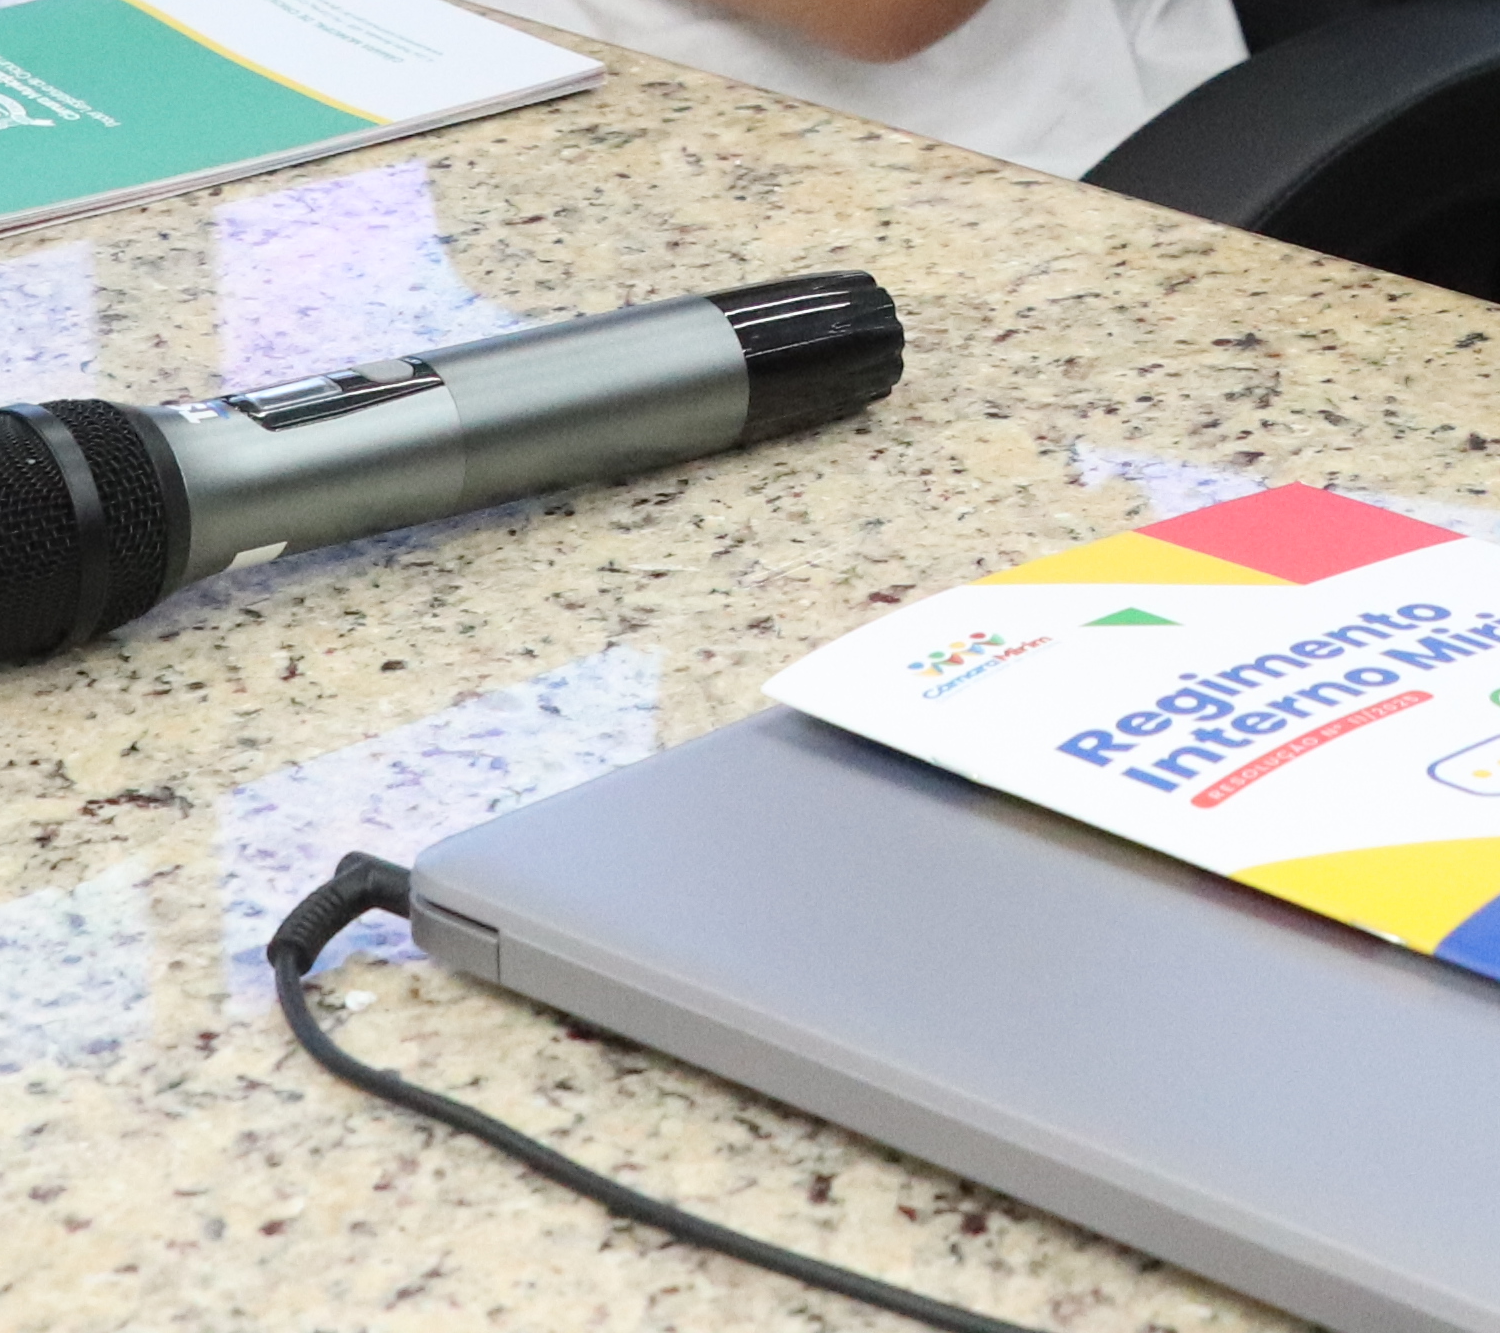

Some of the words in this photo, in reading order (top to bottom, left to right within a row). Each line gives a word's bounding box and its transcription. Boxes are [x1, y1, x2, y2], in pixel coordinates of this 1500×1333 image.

[1056, 603, 1452, 767] Regimento
[1121, 666, 1400, 794] Interno
[1208, 736, 1319, 800] RESOLUÇÃO
[1347, 694, 1420, 725] 11/2025
